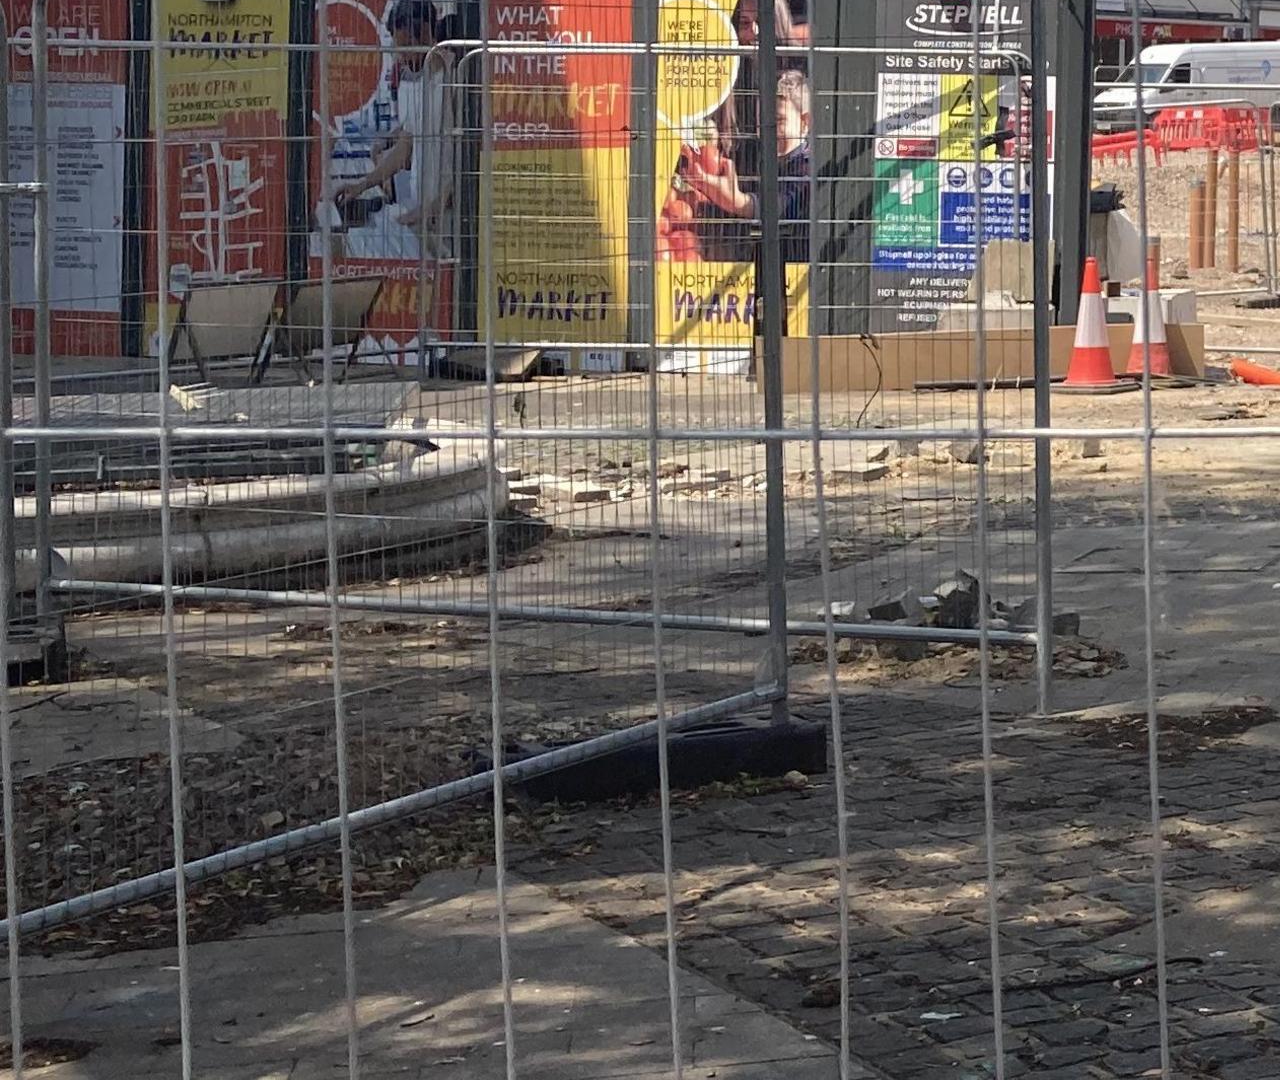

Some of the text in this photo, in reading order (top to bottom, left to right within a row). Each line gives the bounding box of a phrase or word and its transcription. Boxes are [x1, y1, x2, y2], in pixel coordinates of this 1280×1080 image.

[57, 5, 101, 25] ARE
[168, 14, 273, 27] NORTHAMPTON
[496, 6, 564, 25] WHAT
[668, 21, 703, 30] WE'RE
[1115, 23, 1147, 37] PHOE
[169, 28, 274, 59] MARKET
[546, 31, 592, 44] YOU
[668, 32, 703, 41] IN THE
[494, 55, 567, 75] IN THE
[667, 66, 728, 75] FOR LOCAL
[885, 56, 914, 68] Site
[917, 56, 965, 71] Safety
[968, 56, 1010, 69] Starts
[204, 80, 237, 96] OPEN
[667, 78, 722, 88] PRODUCE
[492, 81, 621, 119] MARKET
[492, 122, 550, 141] FOR?
[496, 273, 611, 288] NORTHAMPTON
[673, 273, 790, 288] NORTHAMN
[877, 289, 895, 297] NOT
[498, 286, 613, 322] MARKET
[675, 288, 756, 324] MARK
